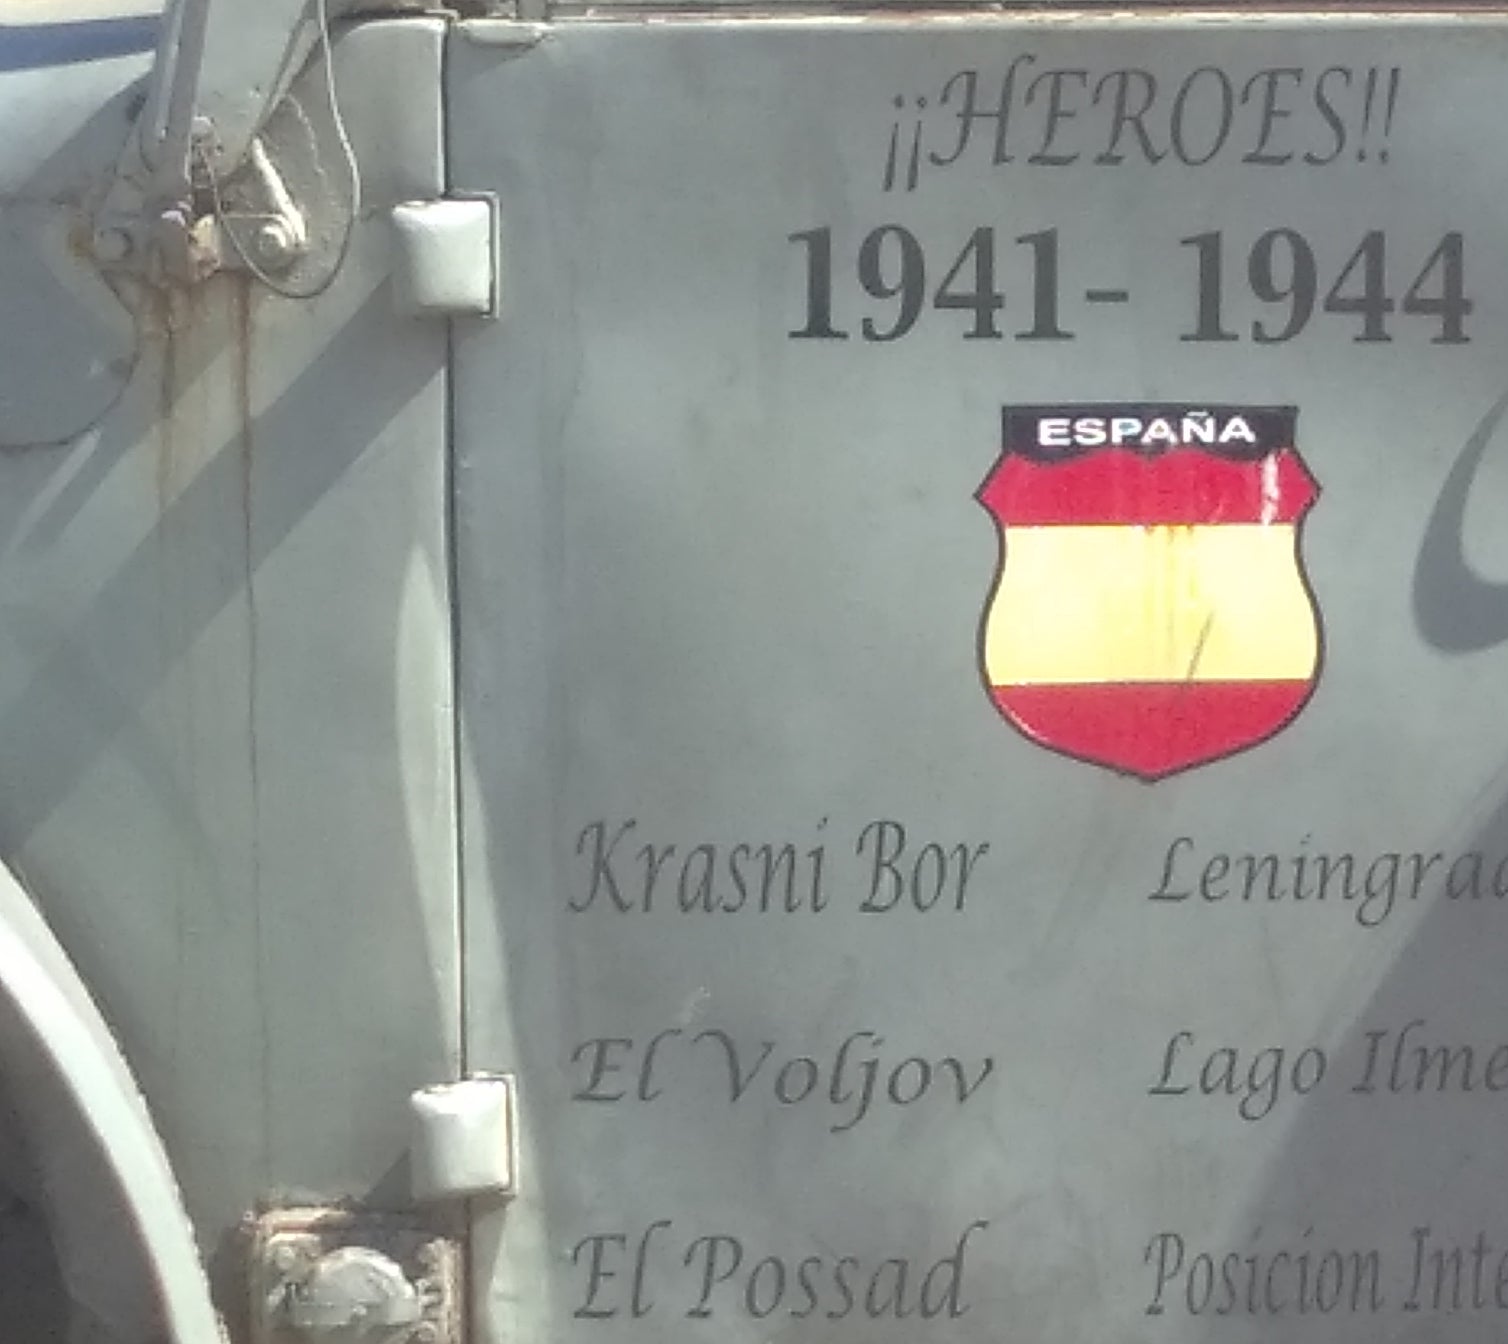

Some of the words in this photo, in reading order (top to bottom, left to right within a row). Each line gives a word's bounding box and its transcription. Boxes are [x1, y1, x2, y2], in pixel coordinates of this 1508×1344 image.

[883, 54, 1401, 191] ¡¡HEROES!!
[1179, 227, 1473, 345] 1944
[1037, 411, 1257, 448] ESPAÑA
[567, 817, 828, 915] Krasni
[856, 819, 991, 915] Bor
[570, 1028, 683, 1102] El
[693, 1029, 995, 1134] Voljov
[1147, 1031, 1327, 1122] Lago
[569, 1219, 672, 1320] El
[682, 1219, 990, 1320] Possad
[1143, 1226, 1385, 1317] Posicion
